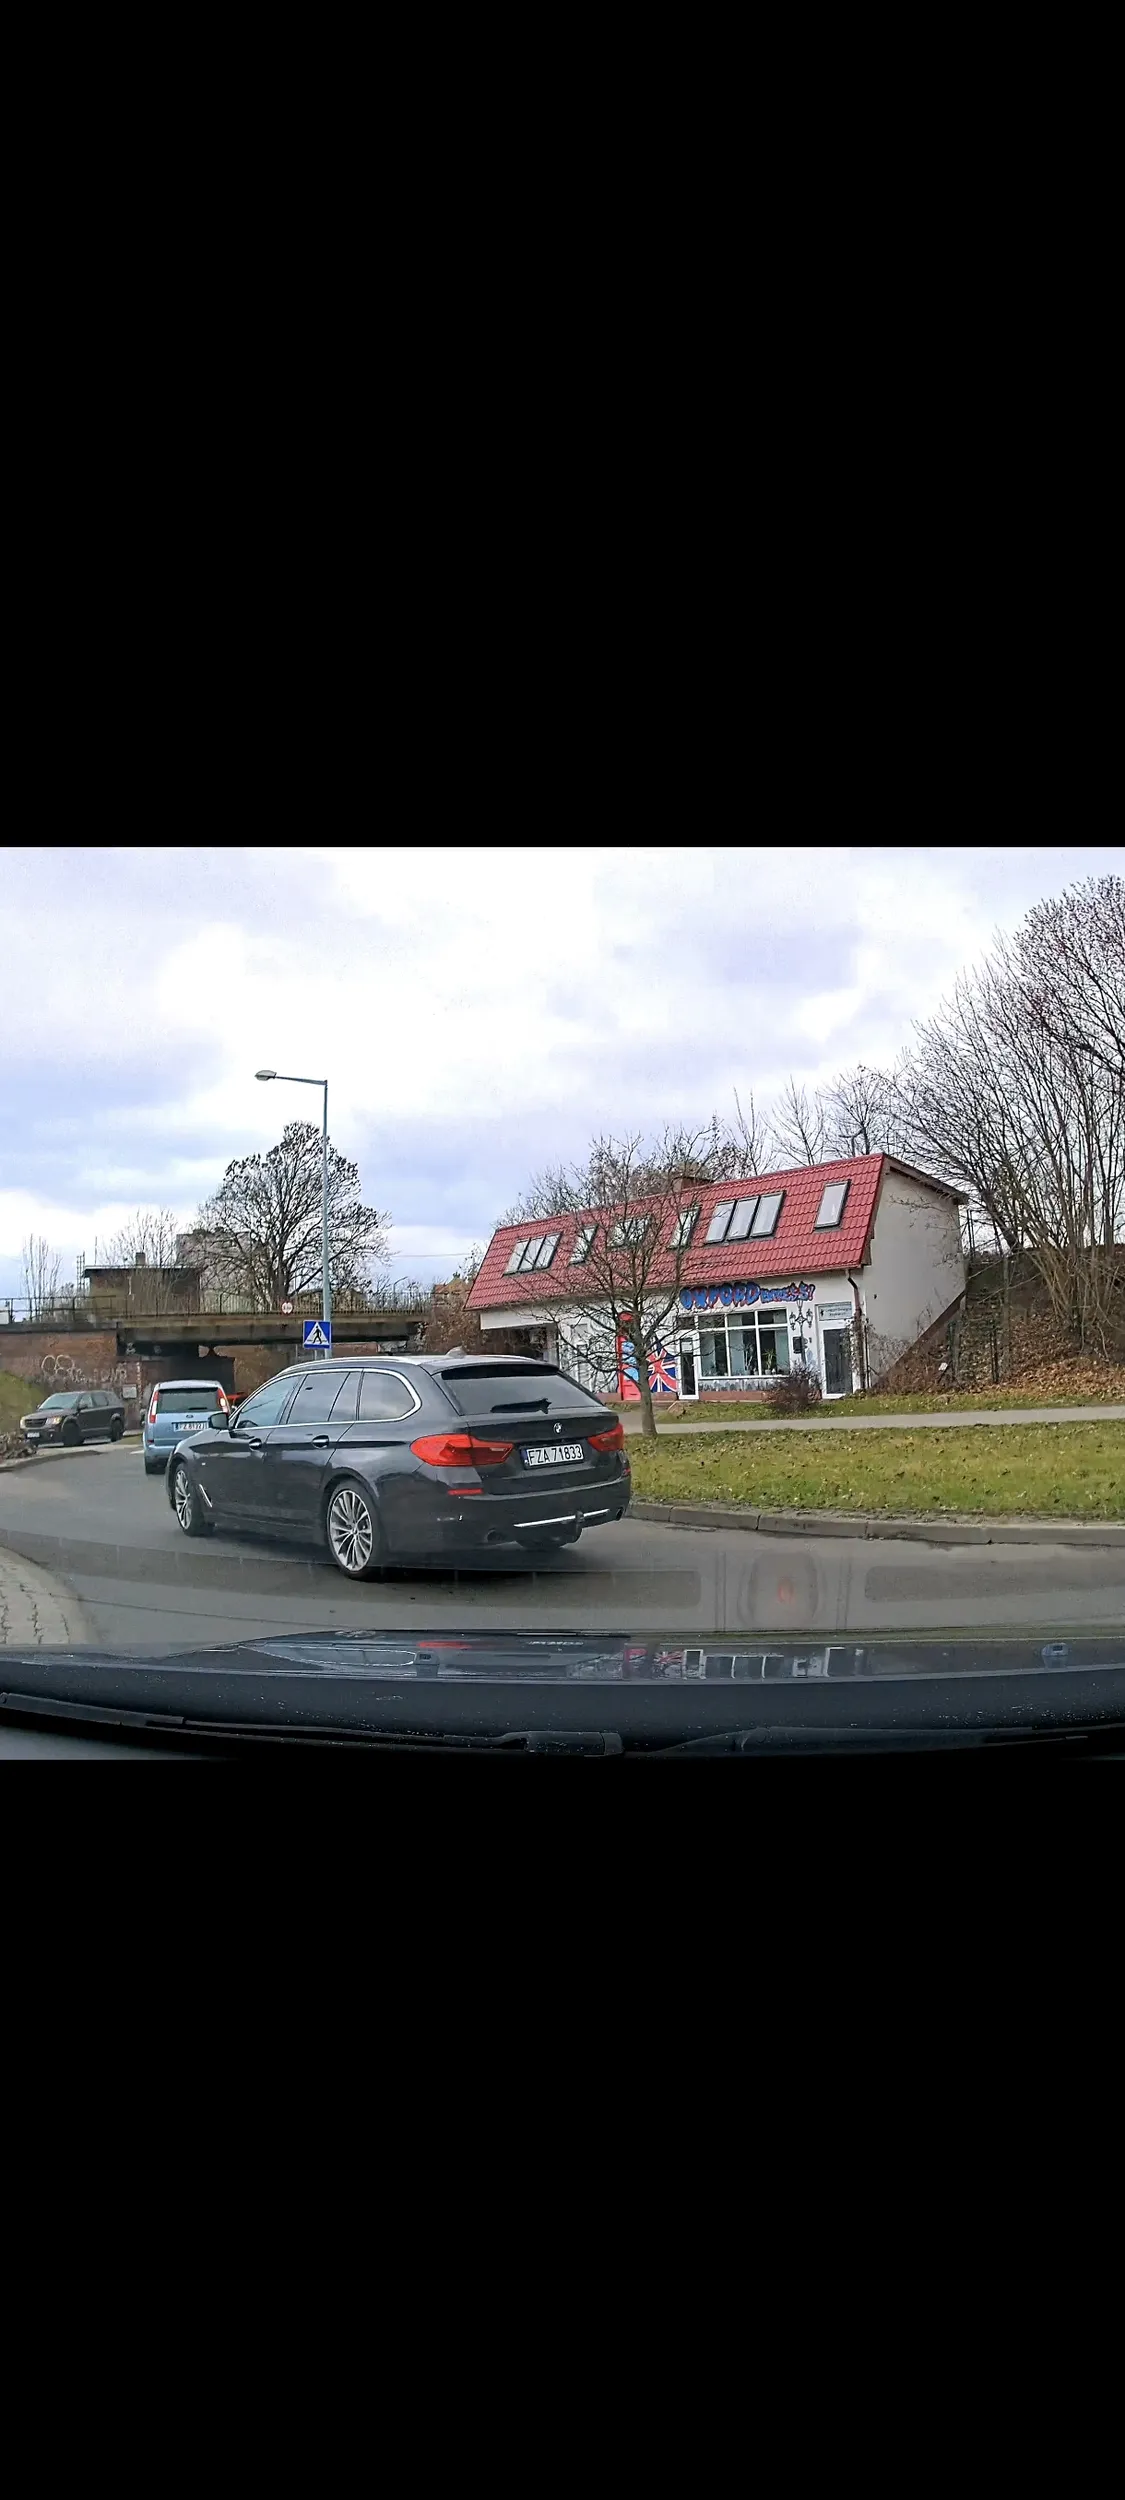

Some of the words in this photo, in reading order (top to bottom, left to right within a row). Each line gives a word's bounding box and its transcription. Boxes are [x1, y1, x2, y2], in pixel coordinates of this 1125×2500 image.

[680, 1282, 760, 1310] OXFORD
[528, 1449, 550, 1464] FZA
[551, 1445, 582, 1461] 71833
